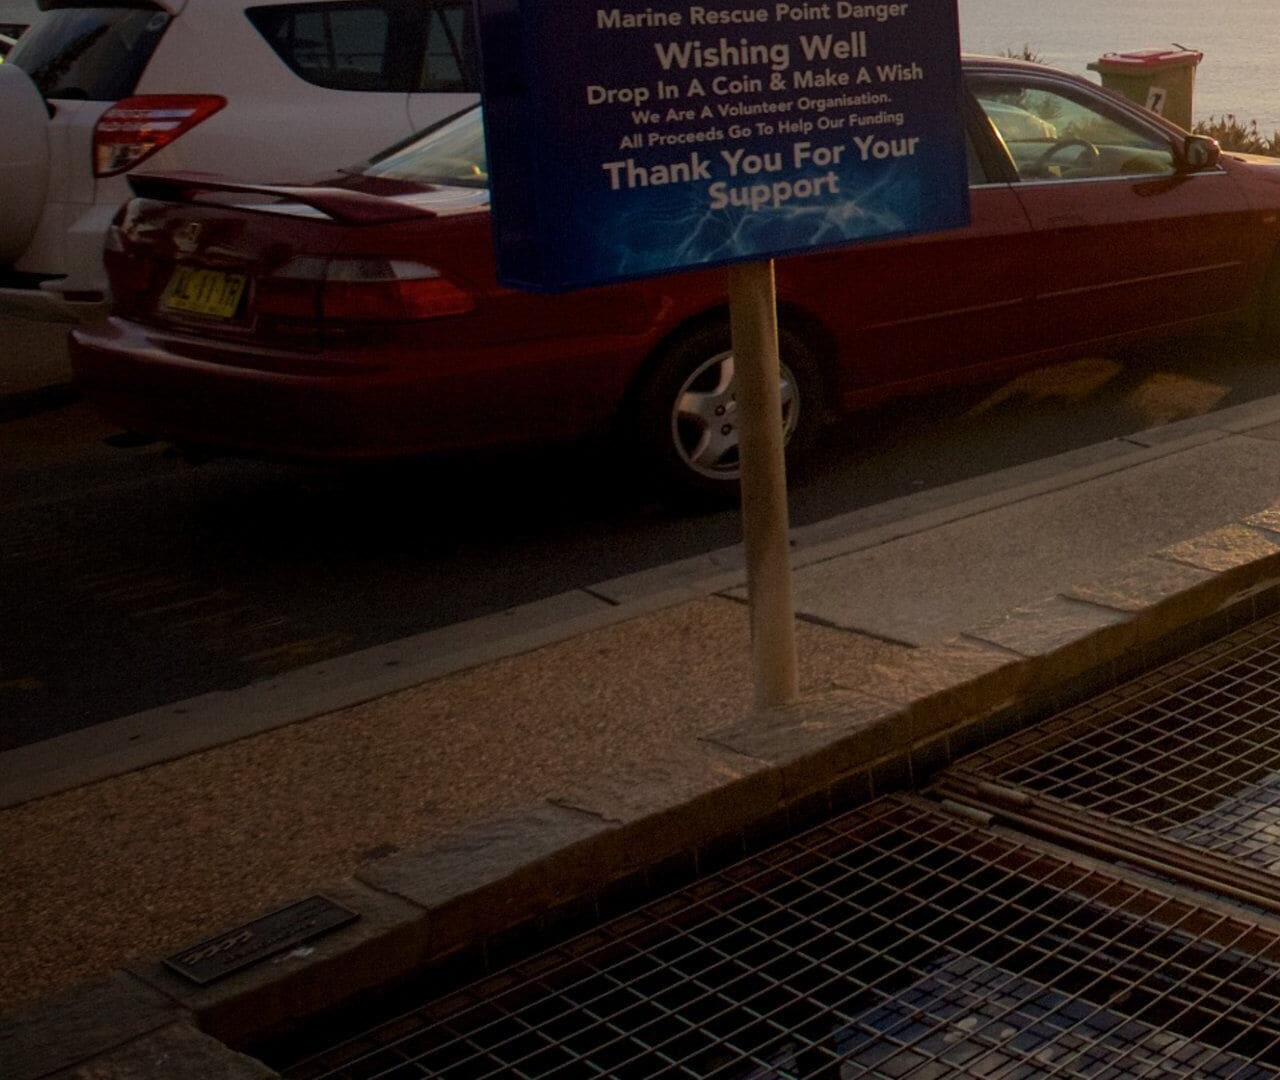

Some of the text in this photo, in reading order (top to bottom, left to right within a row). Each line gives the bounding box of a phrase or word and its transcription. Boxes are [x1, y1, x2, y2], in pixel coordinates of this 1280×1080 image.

[597, 1, 908, 29] Marine Rescue Point Danger
[654, 30, 867, 70] Wishing Well
[587, 62, 923, 106] Drop In A Coin & Make A Wish
[632, 92, 892, 124] We Are A Volunteer Organisation.
[619, 111, 904, 150] All Proceeds Go To Help Our Funding
[602, 134, 920, 191] Thank You For Your
[708, 171, 840, 210] Support
